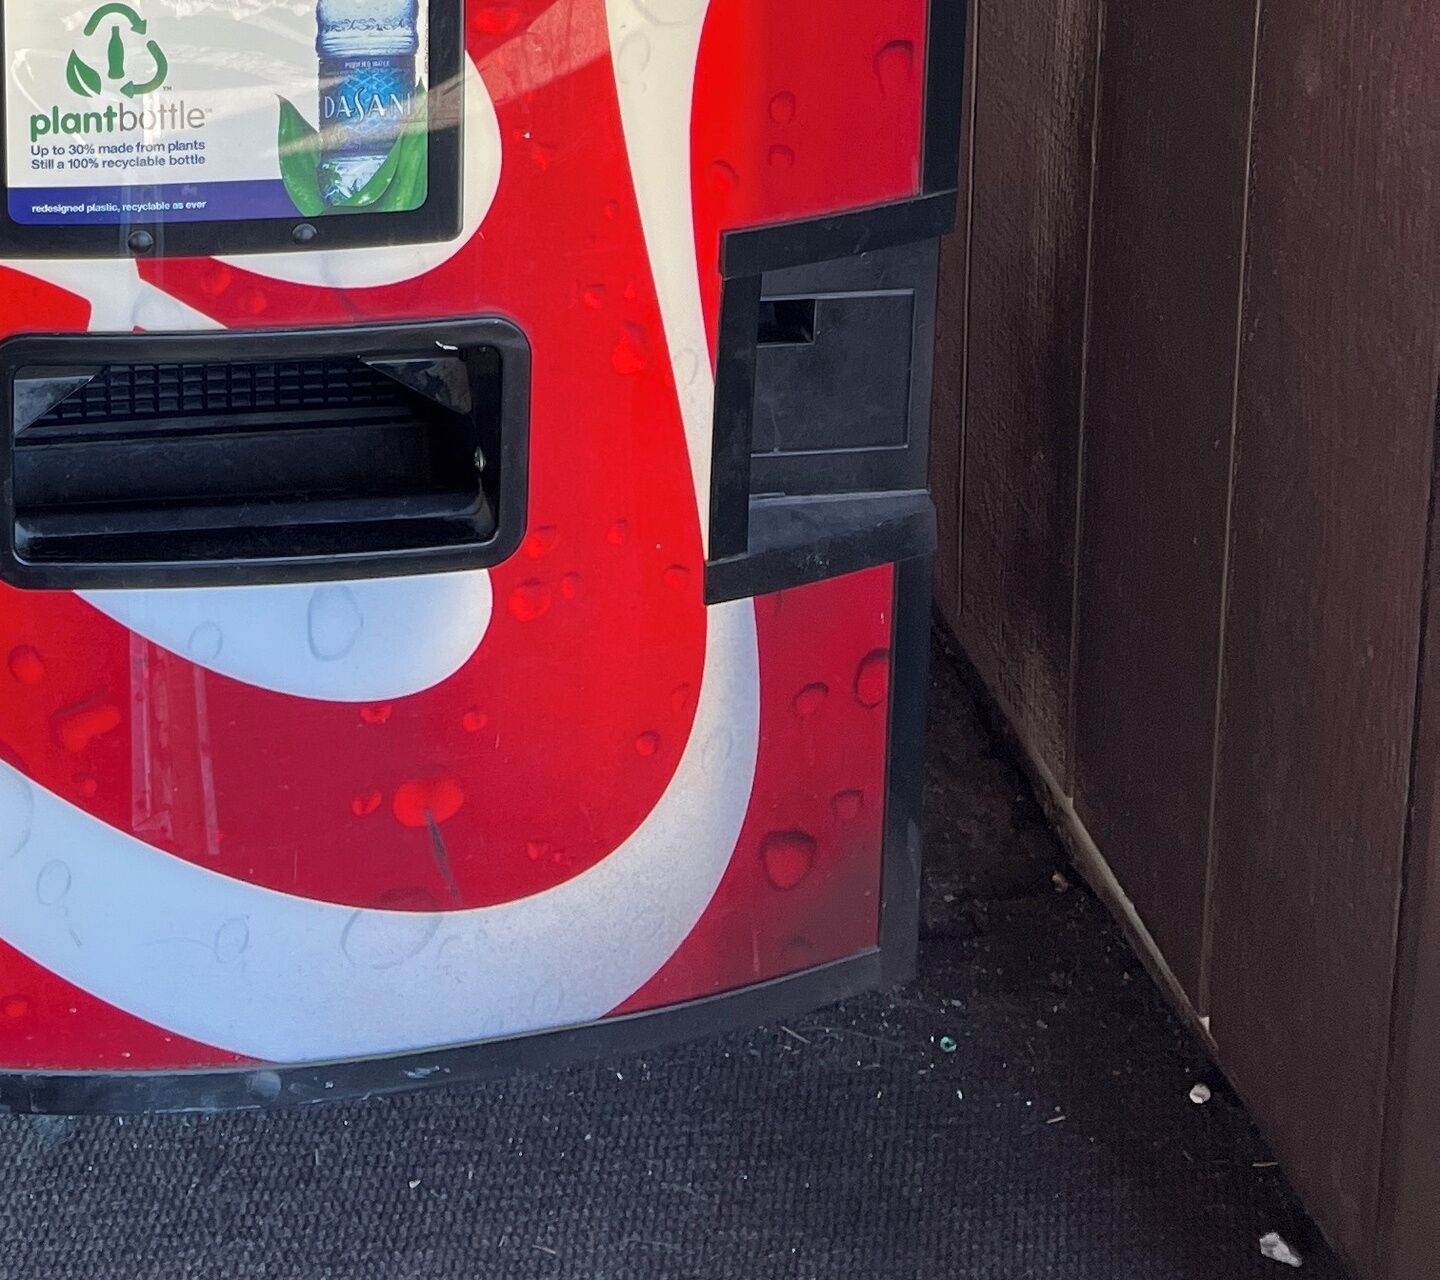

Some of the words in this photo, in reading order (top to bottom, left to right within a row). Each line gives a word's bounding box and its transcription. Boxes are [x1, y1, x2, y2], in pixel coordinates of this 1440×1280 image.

[324, 87, 411, 122] DASANI
[31, 145, 49, 157] Up
[52, 145, 65, 155] to
[68, 144, 95, 155] 30%
[98, 142, 133, 154] made
[136, 142, 165, 153] from
[167, 140, 206, 153] plants
[32, 159, 54, 170] Still
[57, 161, 64, 169] a
[68, 158, 98, 169] 100%
[102, 155, 166, 169] recyclable
[169, 154, 206, 165] bottle
[32, 204, 85, 215] redesigned
[87, 203, 120, 213] plastic,
[122, 202, 170, 213] recyclable
[186, 201, 207, 209] ever
